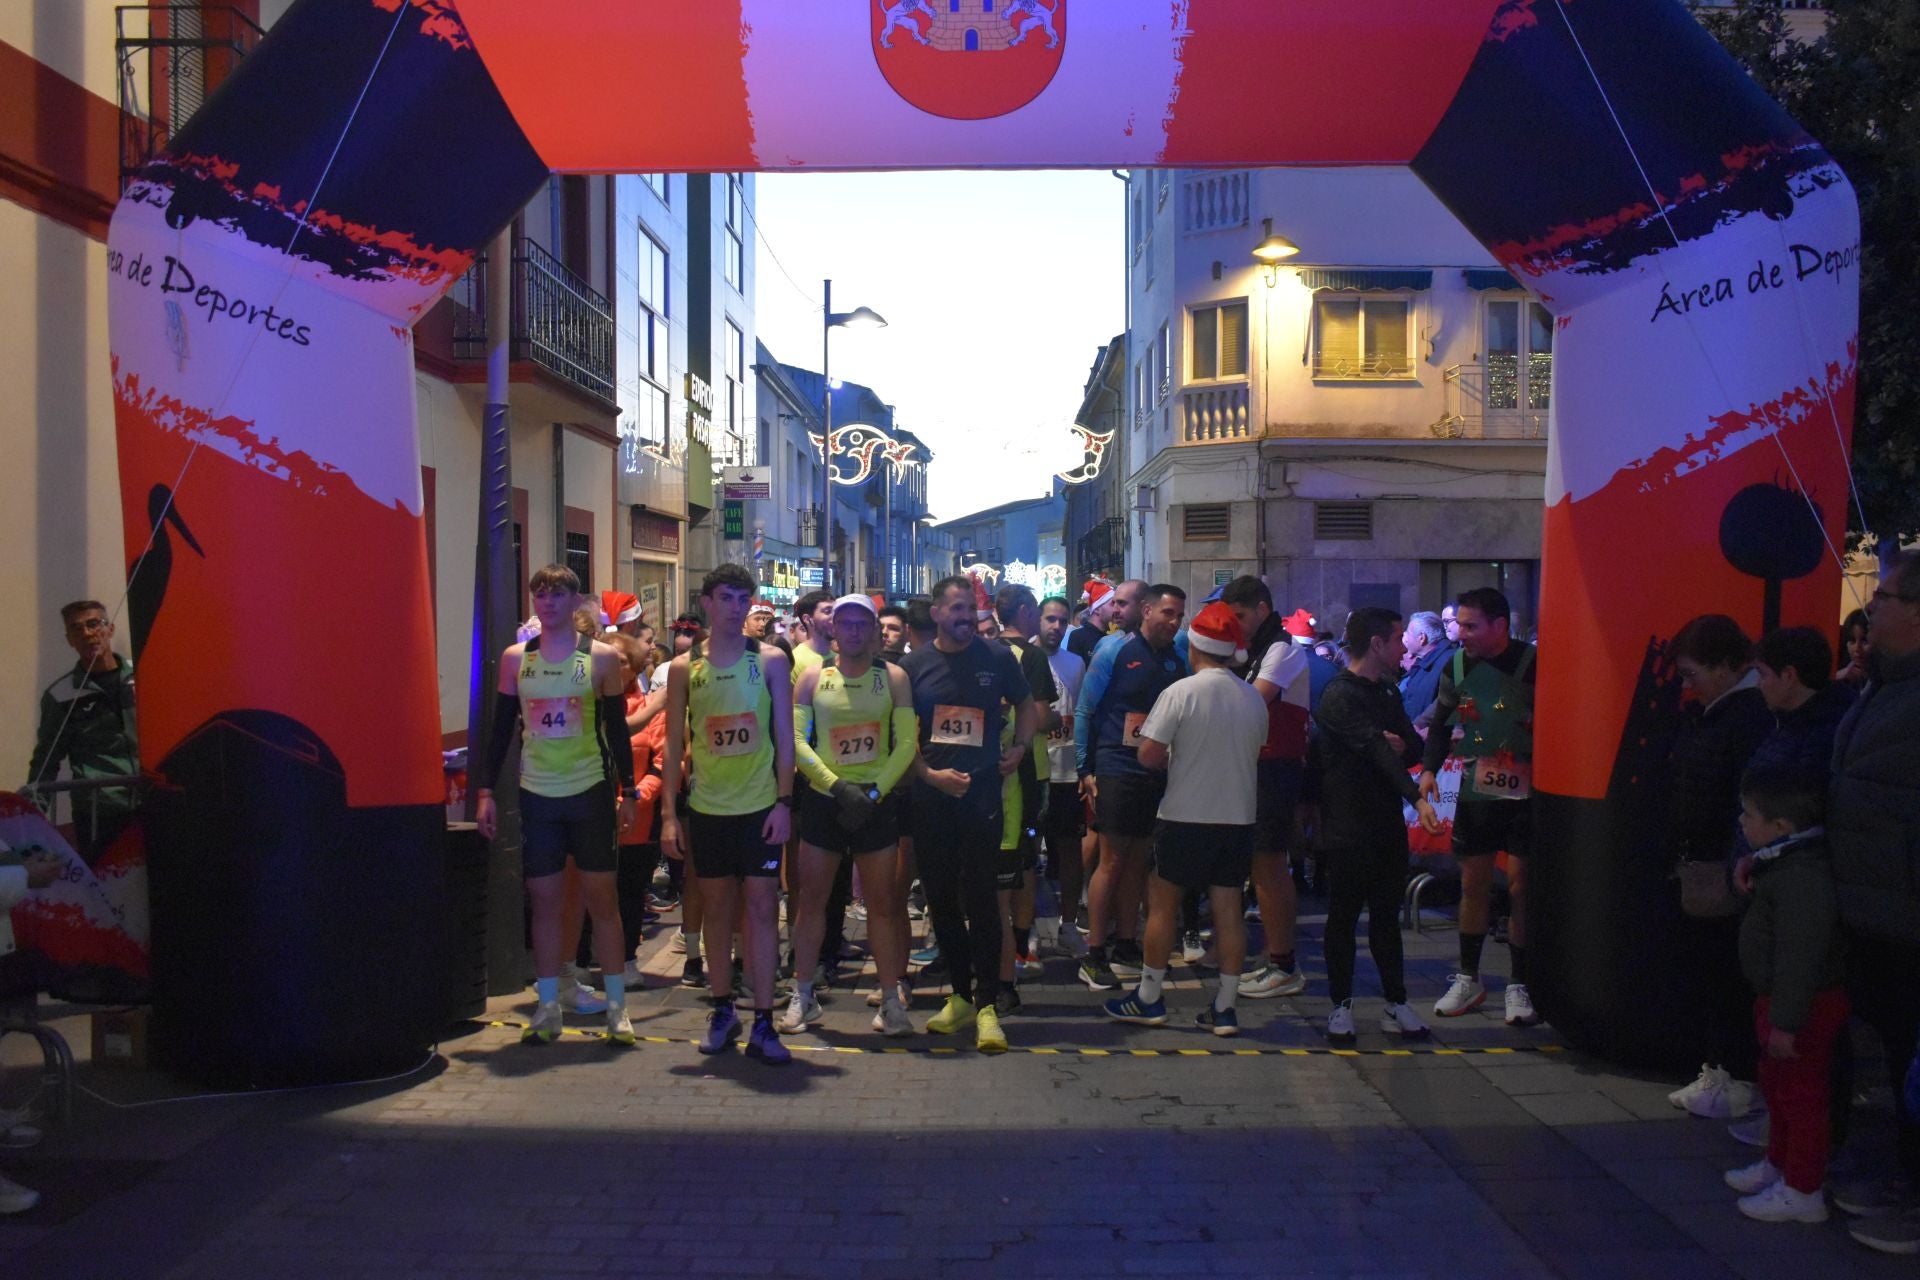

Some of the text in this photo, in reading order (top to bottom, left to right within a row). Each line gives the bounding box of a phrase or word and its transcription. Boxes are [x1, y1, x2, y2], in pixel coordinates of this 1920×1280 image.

[128, 253, 152, 286] de
[160, 256, 310, 346] Deportes
[1651, 282, 1733, 323] Área
[1748, 260, 1783, 293] de
[541, 711, 566, 728] 44
[940, 718, 972, 735] 431
[713, 727, 750, 746] 370
[840, 735, 875, 755] 279
[1482, 771, 1520, 789] 580
